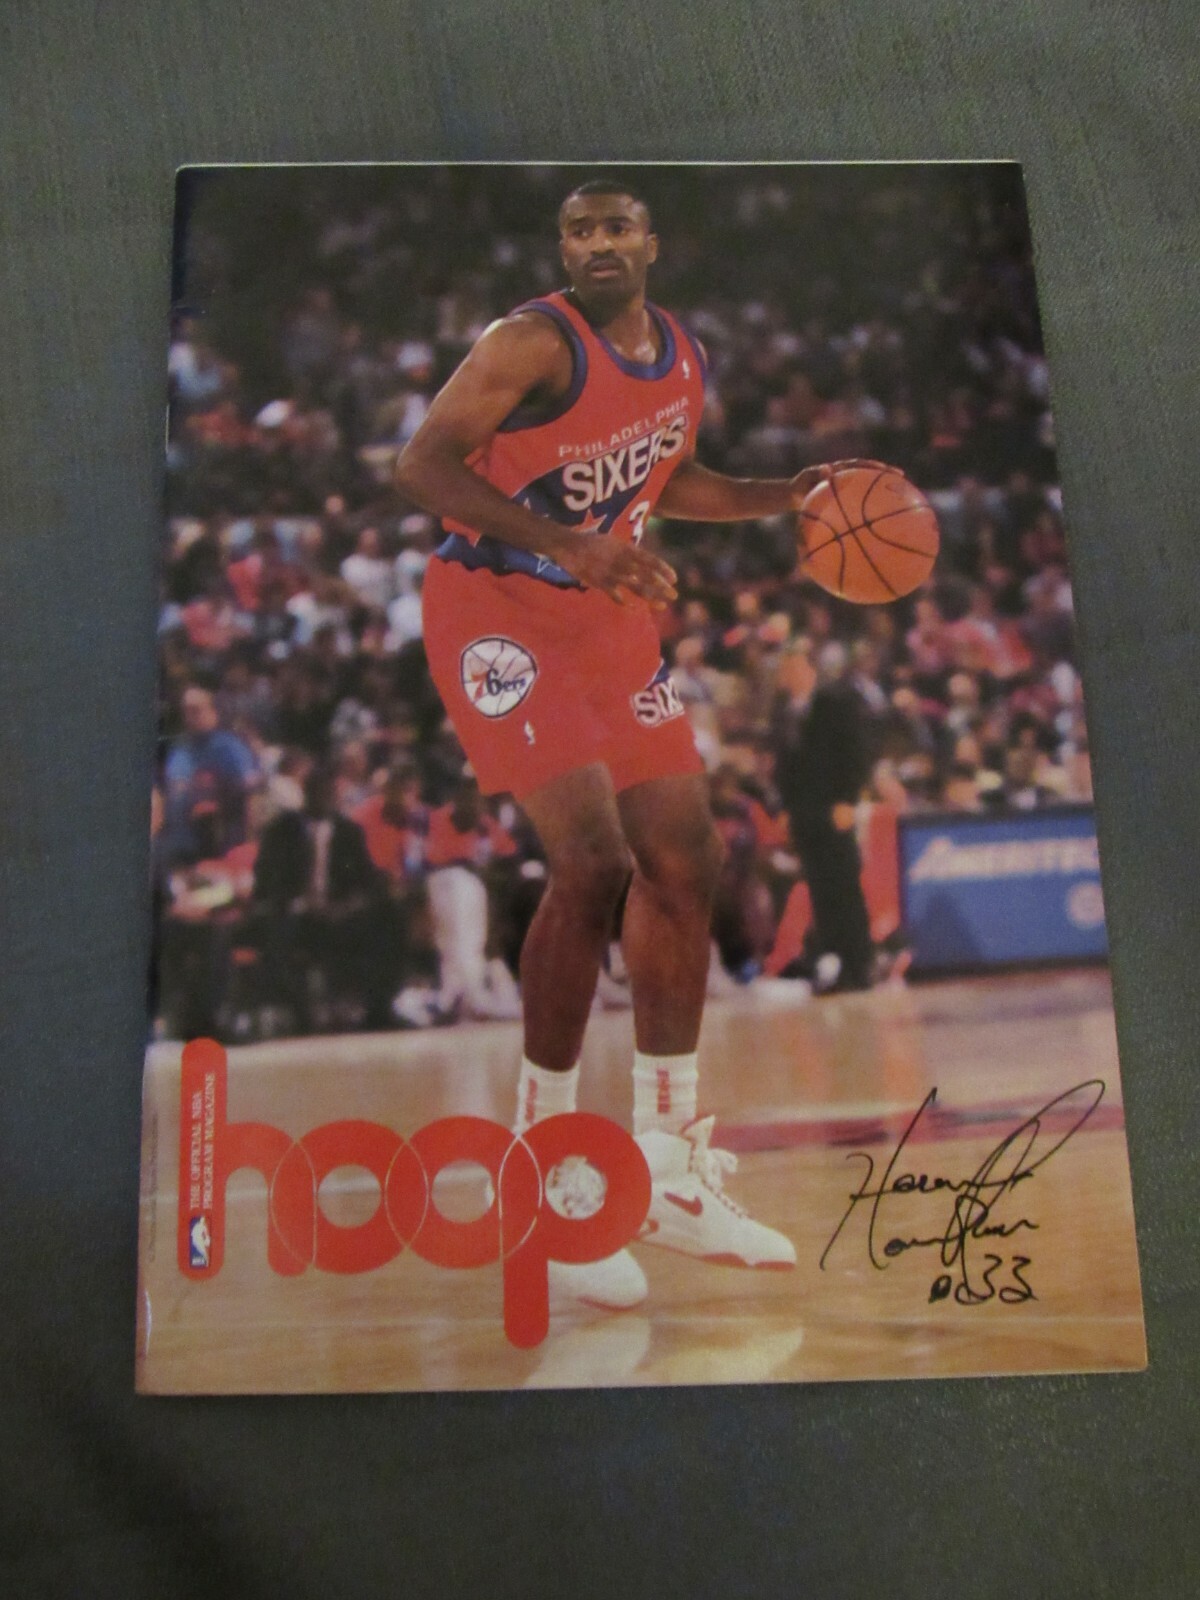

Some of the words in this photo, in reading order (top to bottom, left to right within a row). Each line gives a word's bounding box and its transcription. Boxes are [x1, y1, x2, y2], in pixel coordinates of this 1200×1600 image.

[559, 397, 689, 457] PHILADELPHIA
[562, 415, 687, 512] SIXERS
[204, 1073, 216, 1141] MAGAZINE
[191, 1122, 201, 1182] OFFICIAL
[203, 1143, 213, 1210] PROGRAM
[177, 1036, 652, 1350] hoop
[190, 1184, 200, 1210] THE
